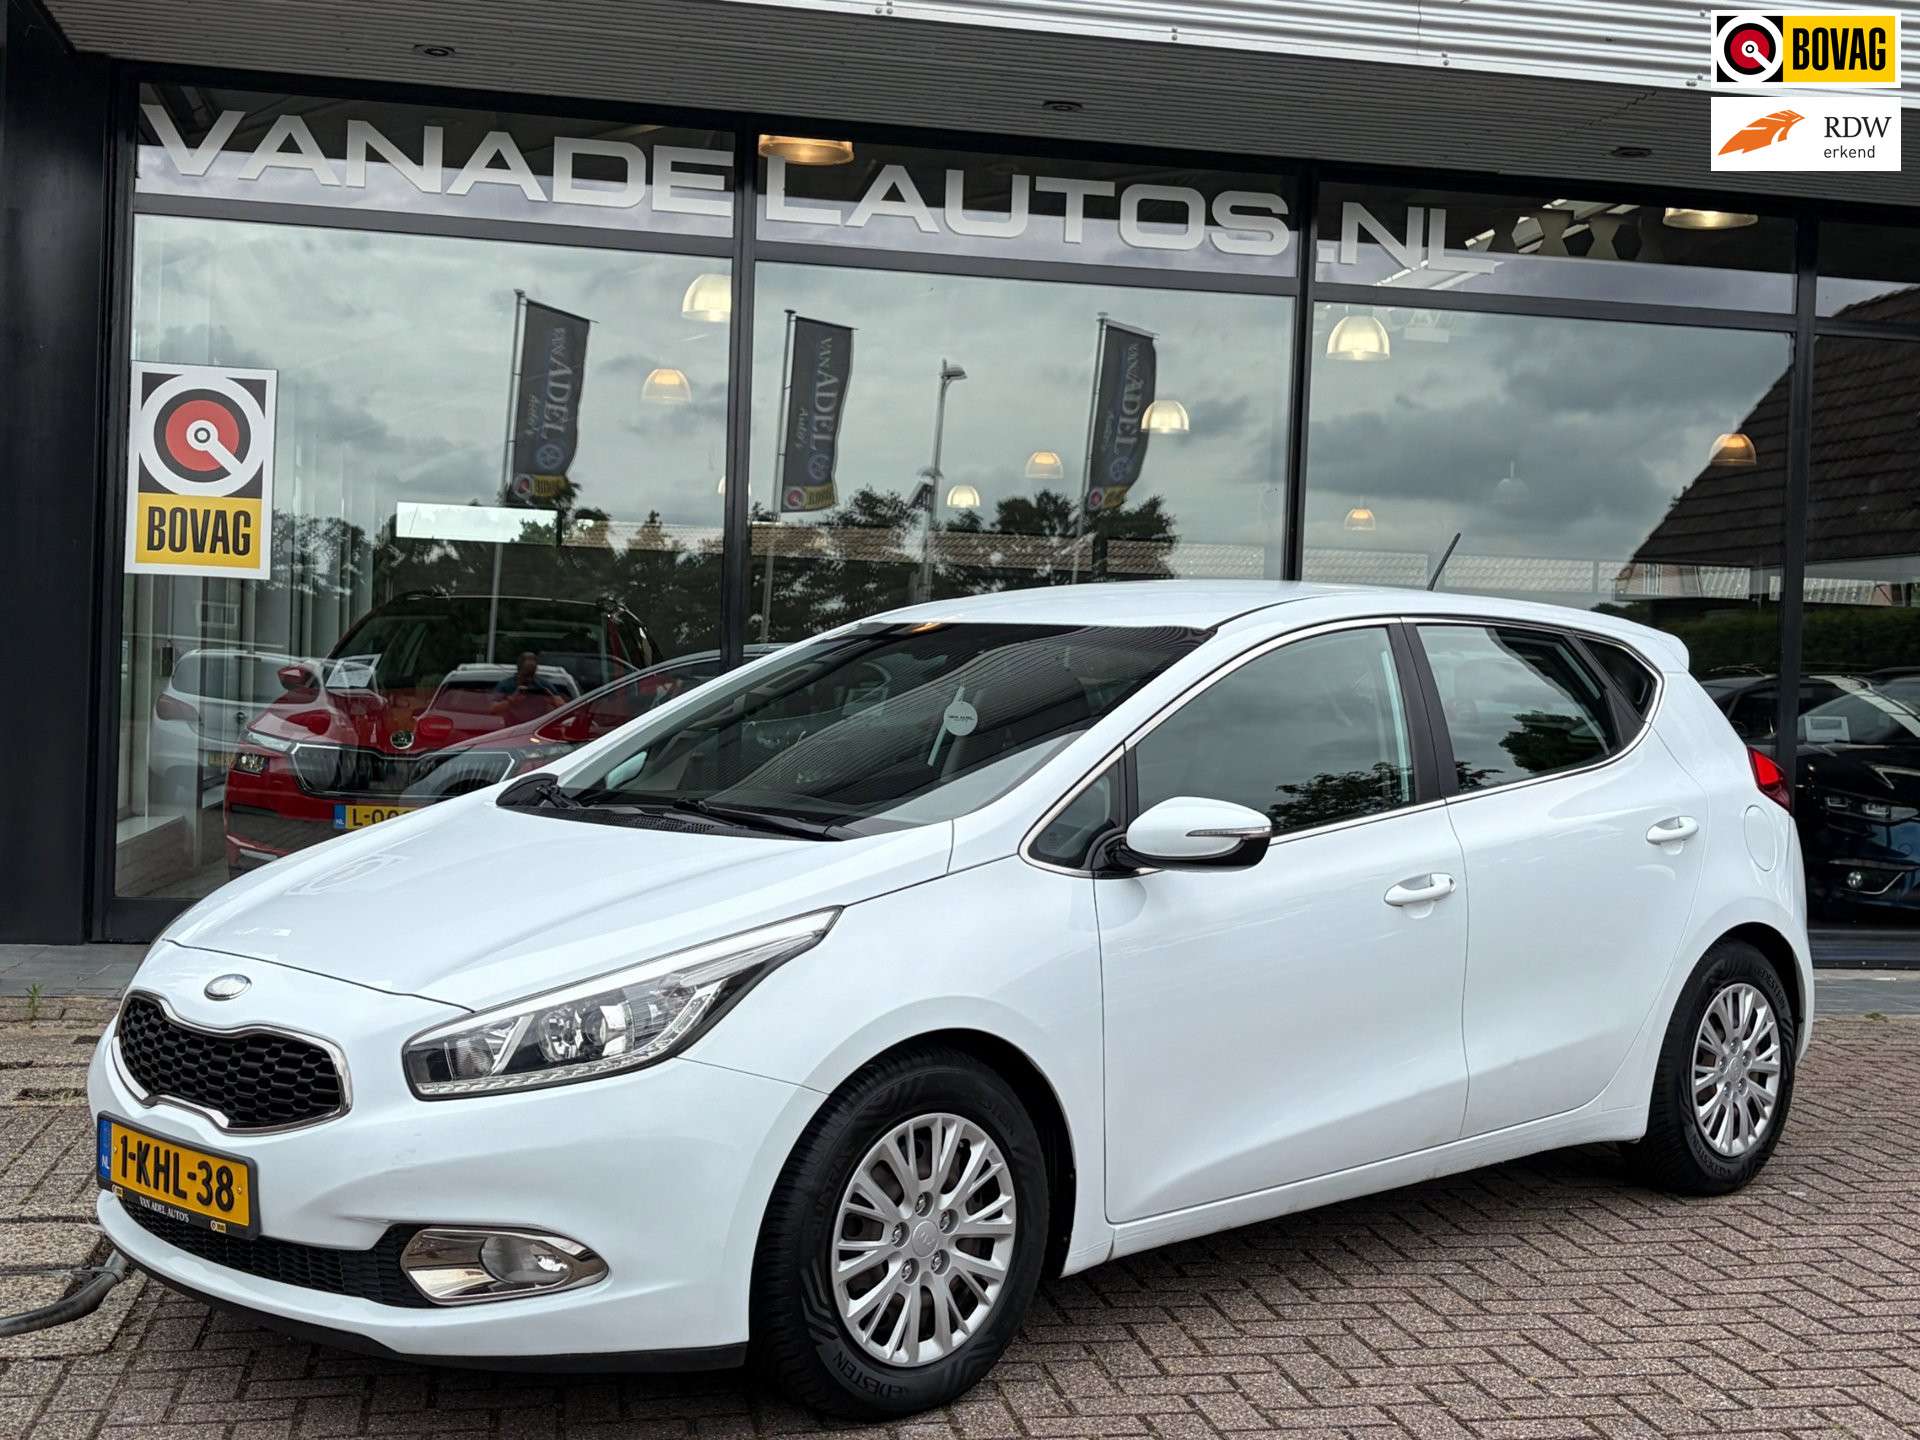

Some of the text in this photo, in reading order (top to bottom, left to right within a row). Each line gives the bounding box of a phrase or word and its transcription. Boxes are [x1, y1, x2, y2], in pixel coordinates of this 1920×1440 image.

[146, 505, 251, 557] BOVAG
[335, 817, 345, 826] NL
[352, 807, 412, 827] L-0
[101, 1154, 110, 1170] NL
[120, 1134, 235, 1213] 1-KHL-38
